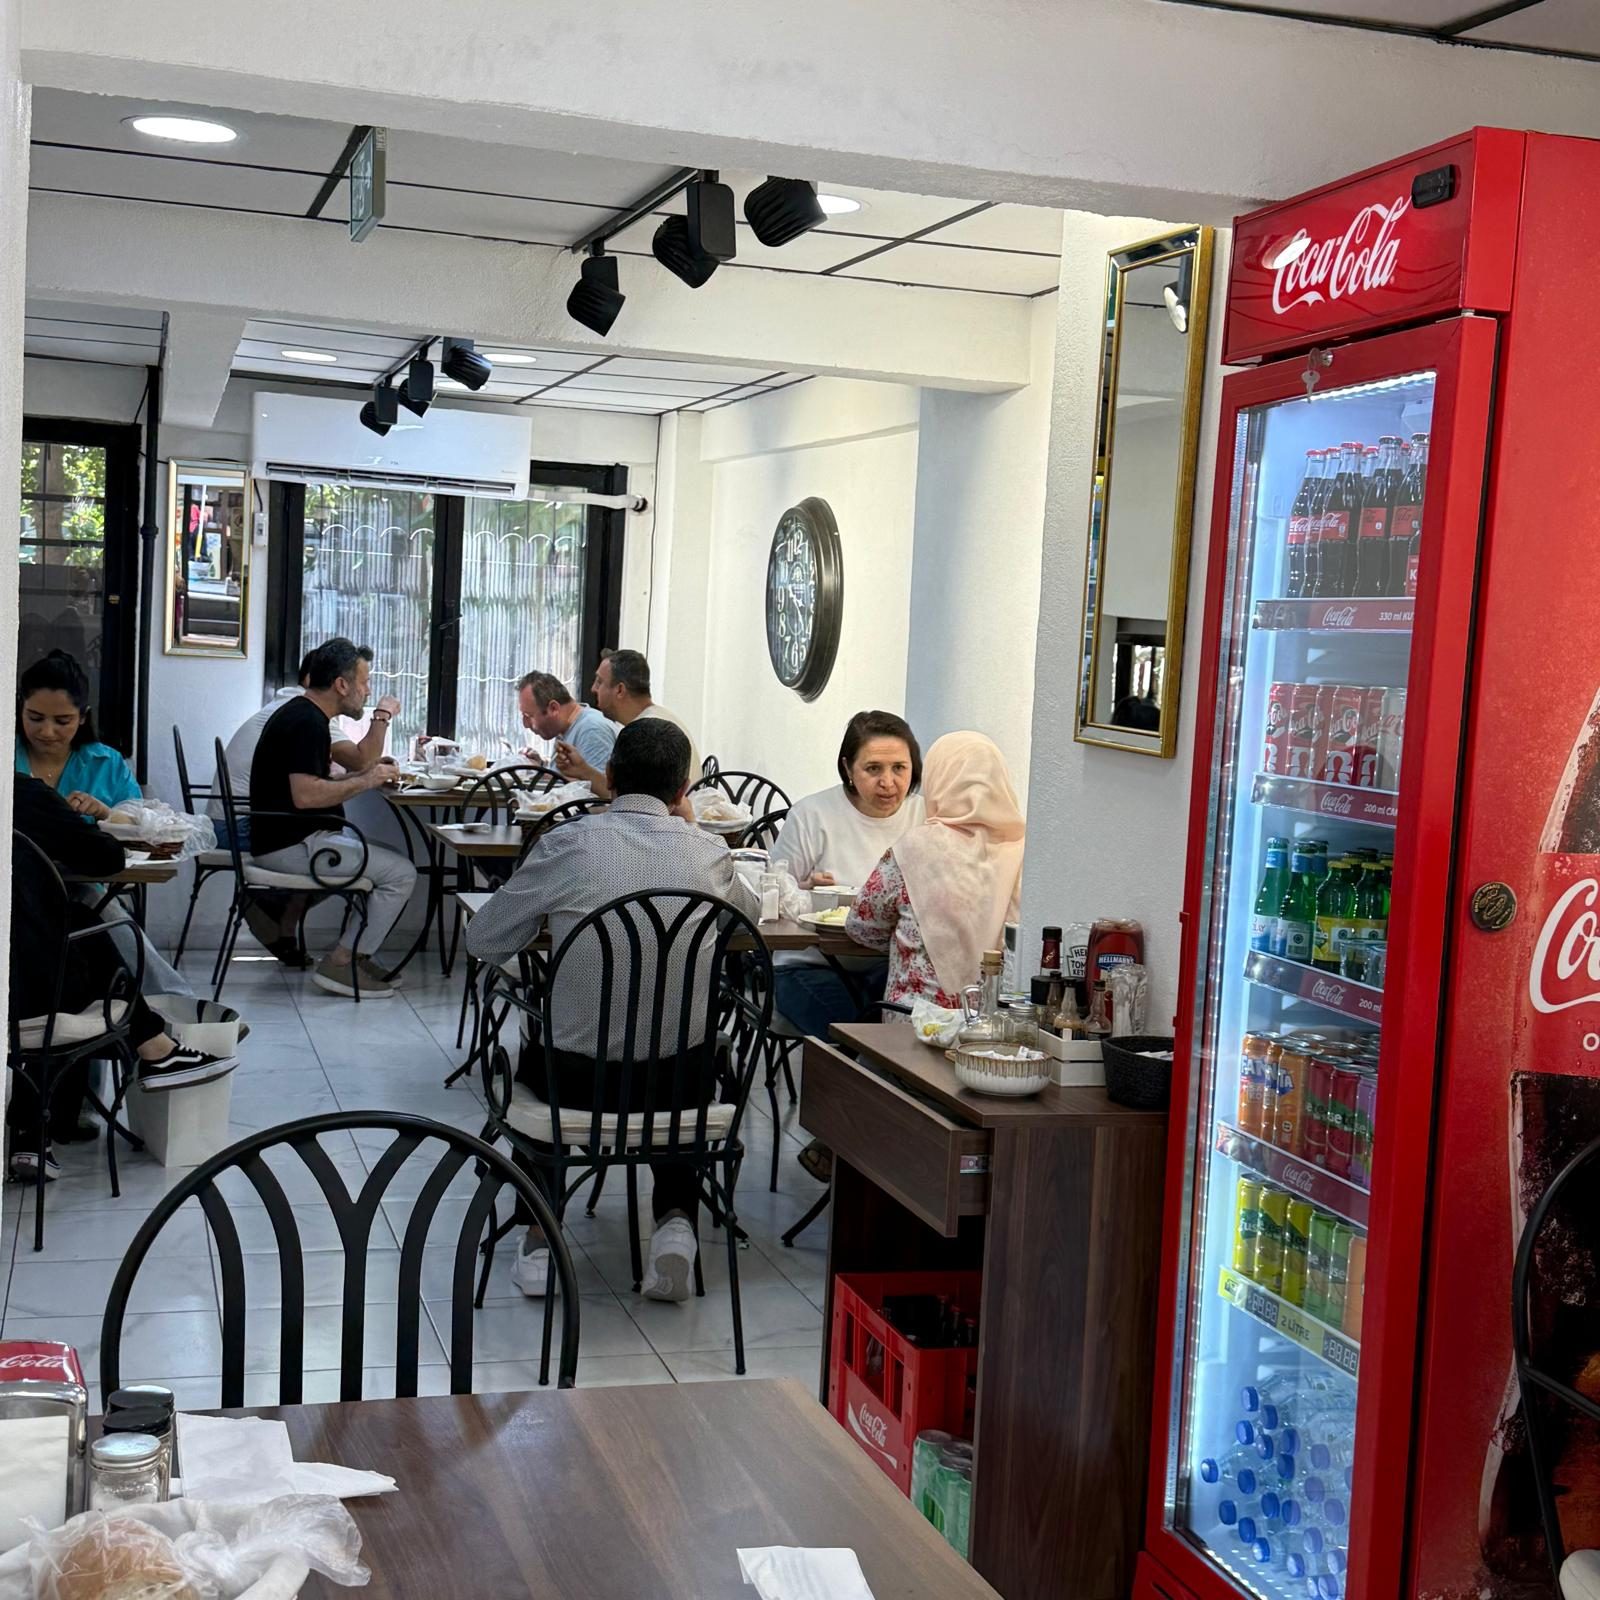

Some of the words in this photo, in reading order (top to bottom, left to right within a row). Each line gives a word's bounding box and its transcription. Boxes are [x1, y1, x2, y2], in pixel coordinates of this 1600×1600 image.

[794, 529, 803, 555] 12
[777, 585, 785, 612] 9
[779, 612, 786, 638] 8
[784, 636, 791, 659] 7
[791, 641, 799, 667] 6
[799, 637, 807, 661] 5
[1363, 803, 1377, 814] 200
[1358, 998, 1373, 1010] 200
[0, 1354, 69, 1369] Cola
